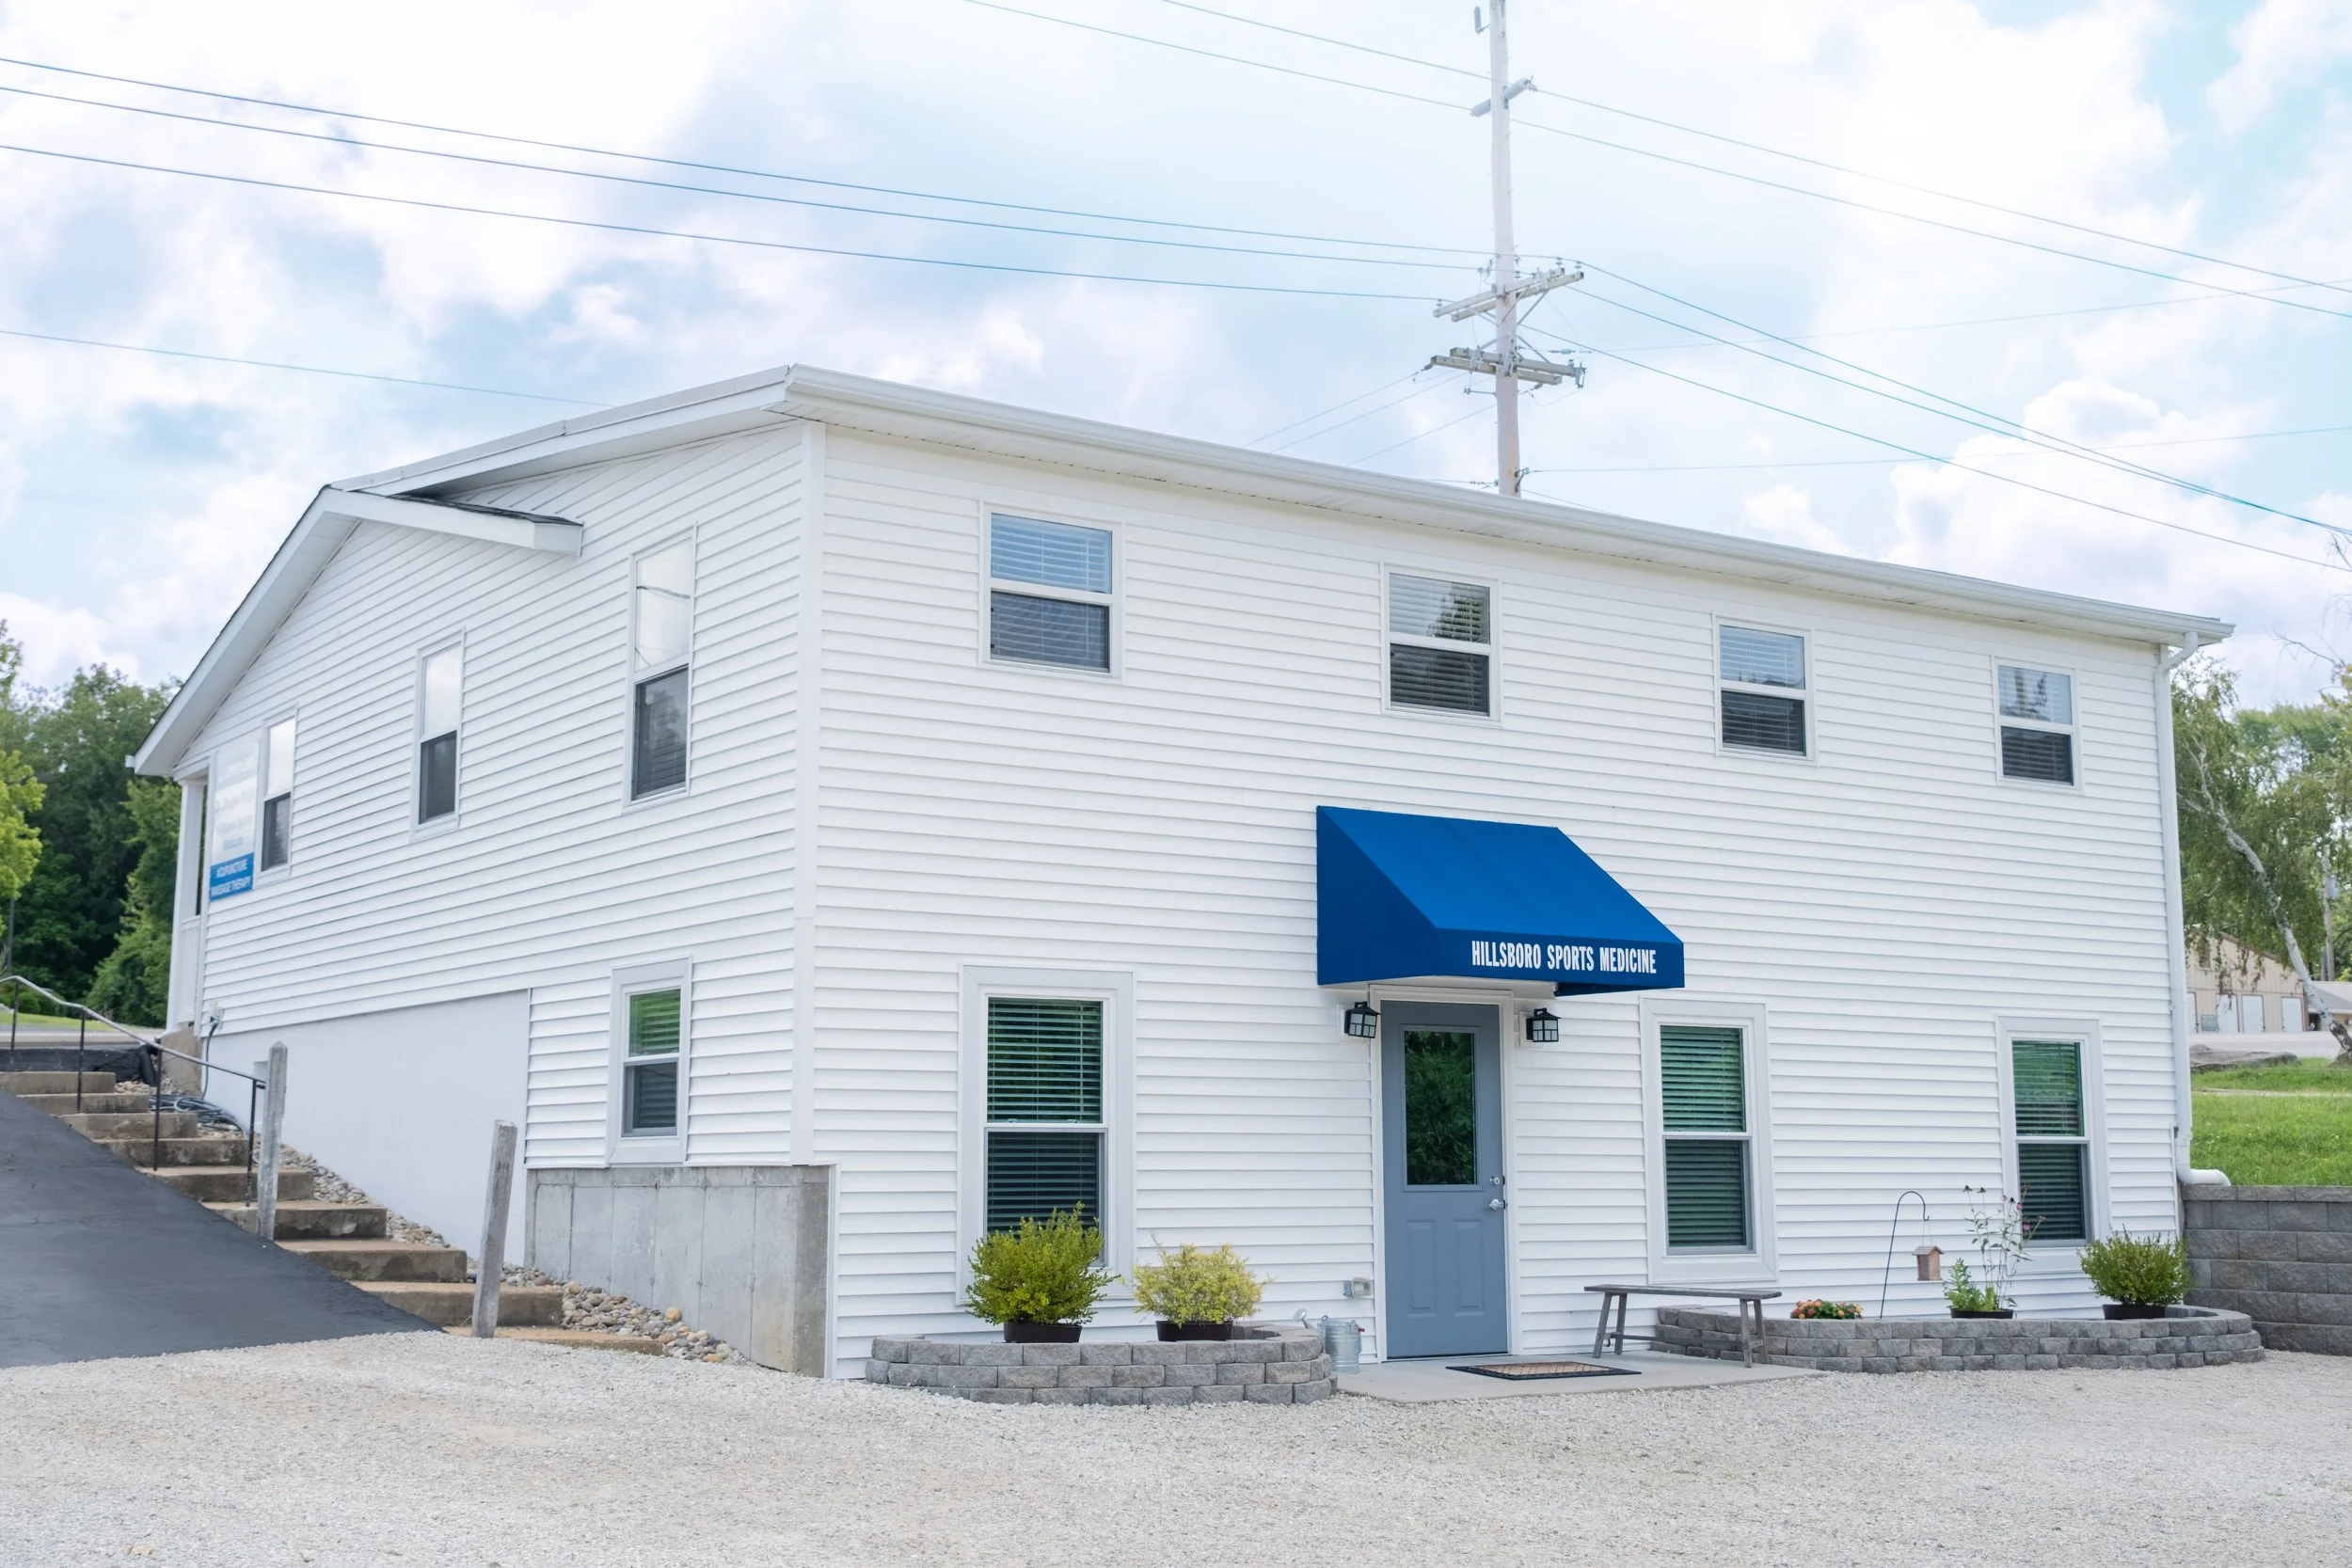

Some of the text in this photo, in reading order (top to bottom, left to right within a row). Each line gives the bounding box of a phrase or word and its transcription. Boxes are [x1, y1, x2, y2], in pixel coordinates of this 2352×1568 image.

[1471, 941, 1657, 974] HILLSBORO SPORTS MEDICINE
